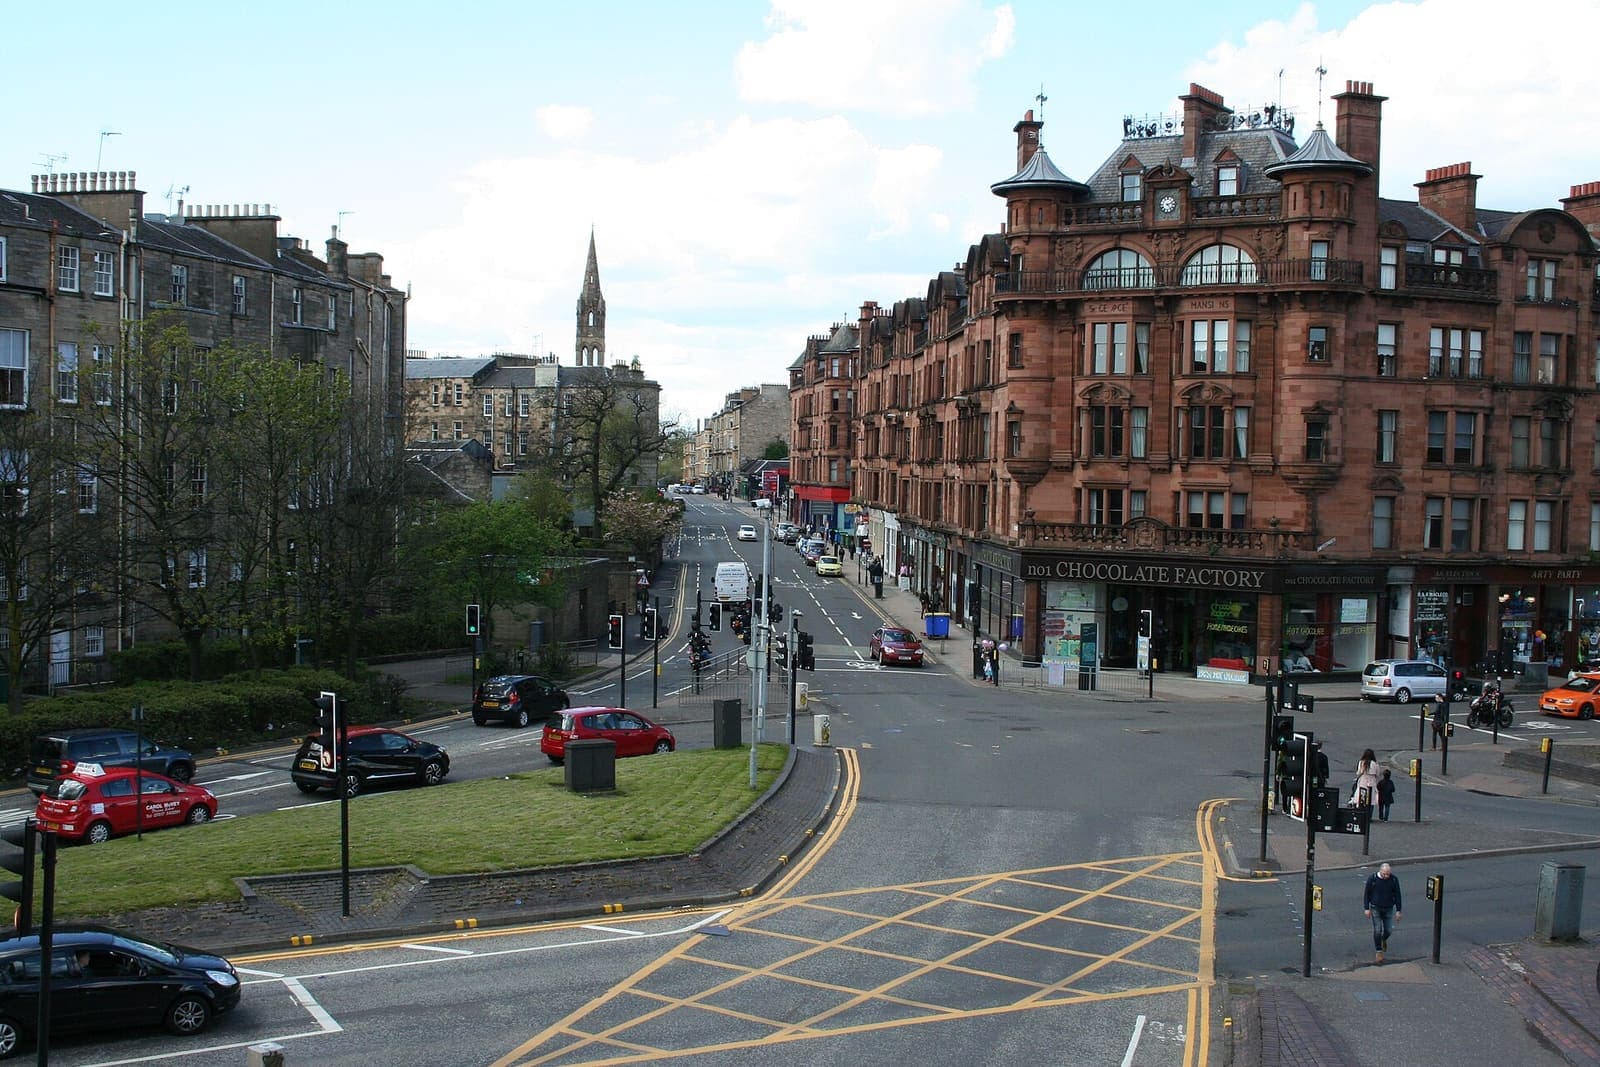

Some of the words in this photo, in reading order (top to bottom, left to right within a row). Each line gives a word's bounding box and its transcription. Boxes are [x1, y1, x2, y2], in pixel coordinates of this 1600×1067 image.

[1056, 561, 1170, 584] CHOCOLATE
[1175, 567, 1265, 588] FACTORY
[1530, 569, 1552, 579] ARTY
[1557, 569, 1583, 579] PARTY
[1296, 576, 1341, 585] CHOCOLATE
[1342, 576, 1375, 585] FACTORY
